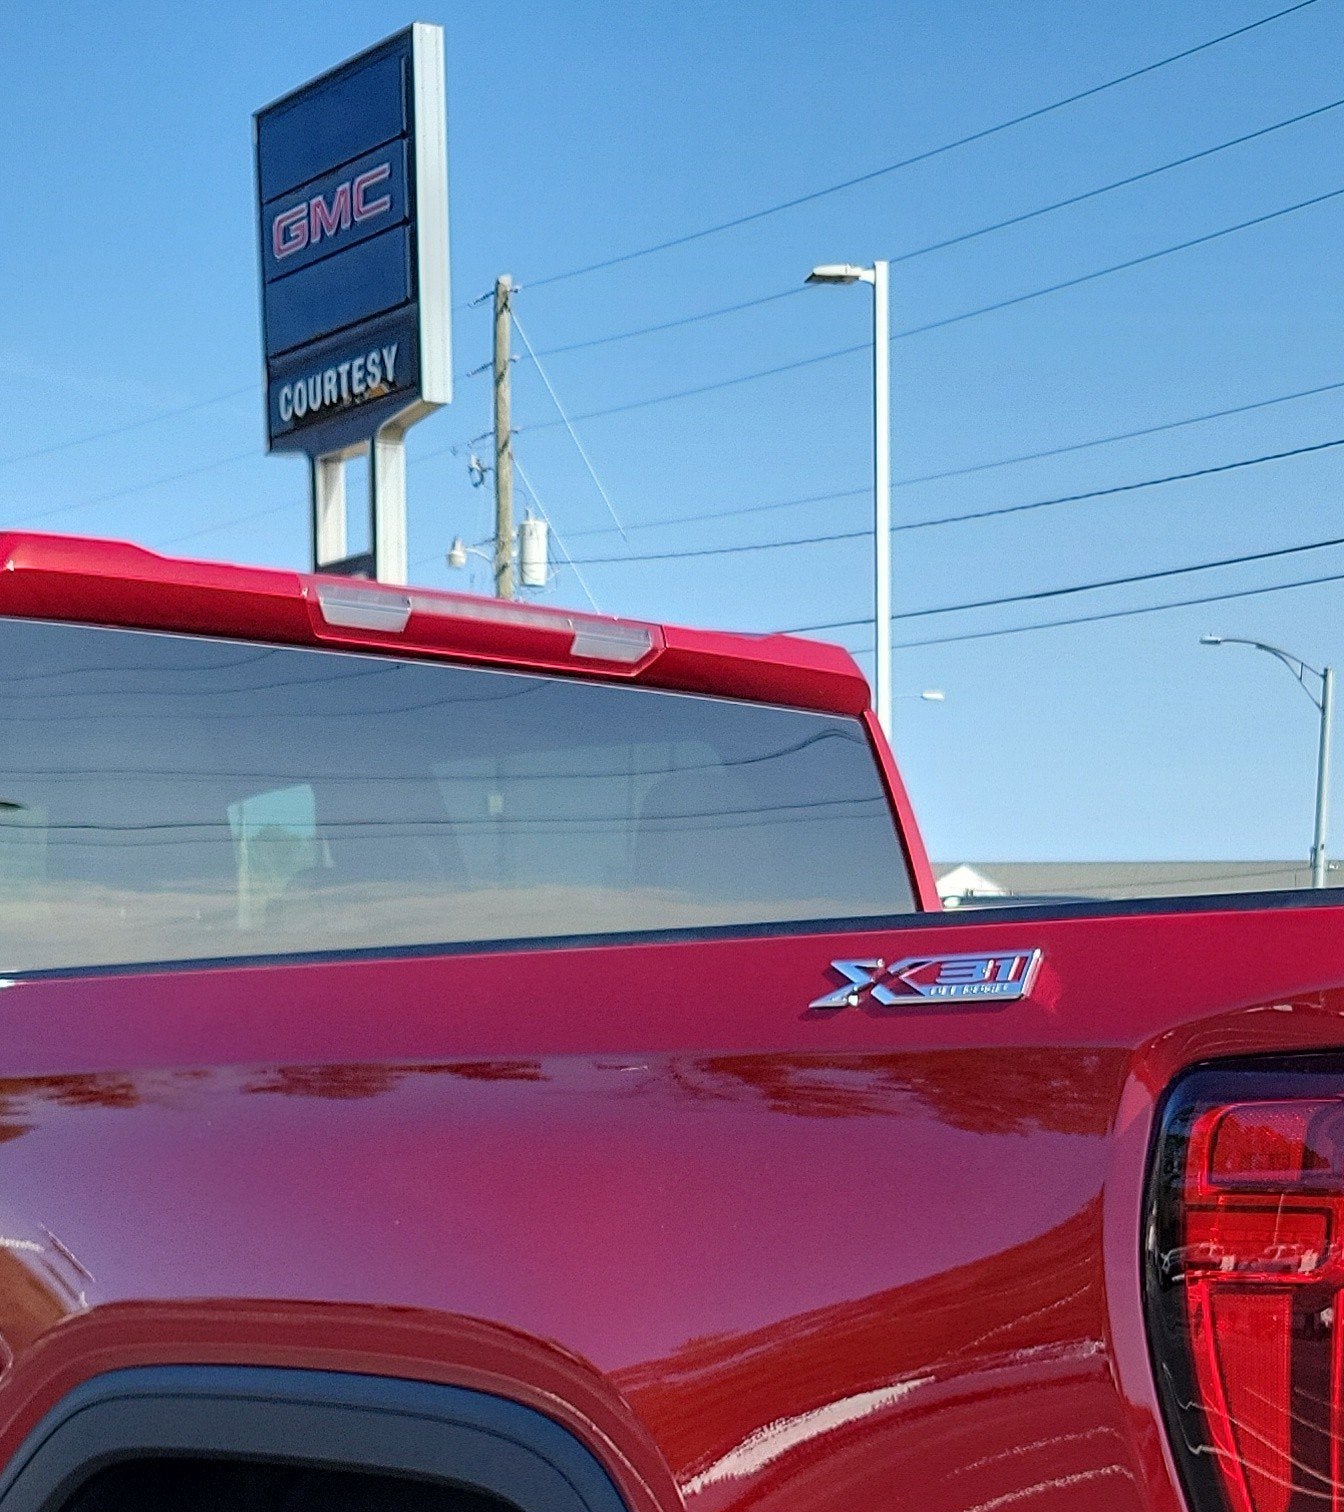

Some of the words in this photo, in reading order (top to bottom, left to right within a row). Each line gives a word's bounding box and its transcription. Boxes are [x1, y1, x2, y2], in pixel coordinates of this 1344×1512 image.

[272, 161, 391, 260] GMC
[278, 342, 398, 423] COURTESY
[808, 947, 1042, 1007] X31
